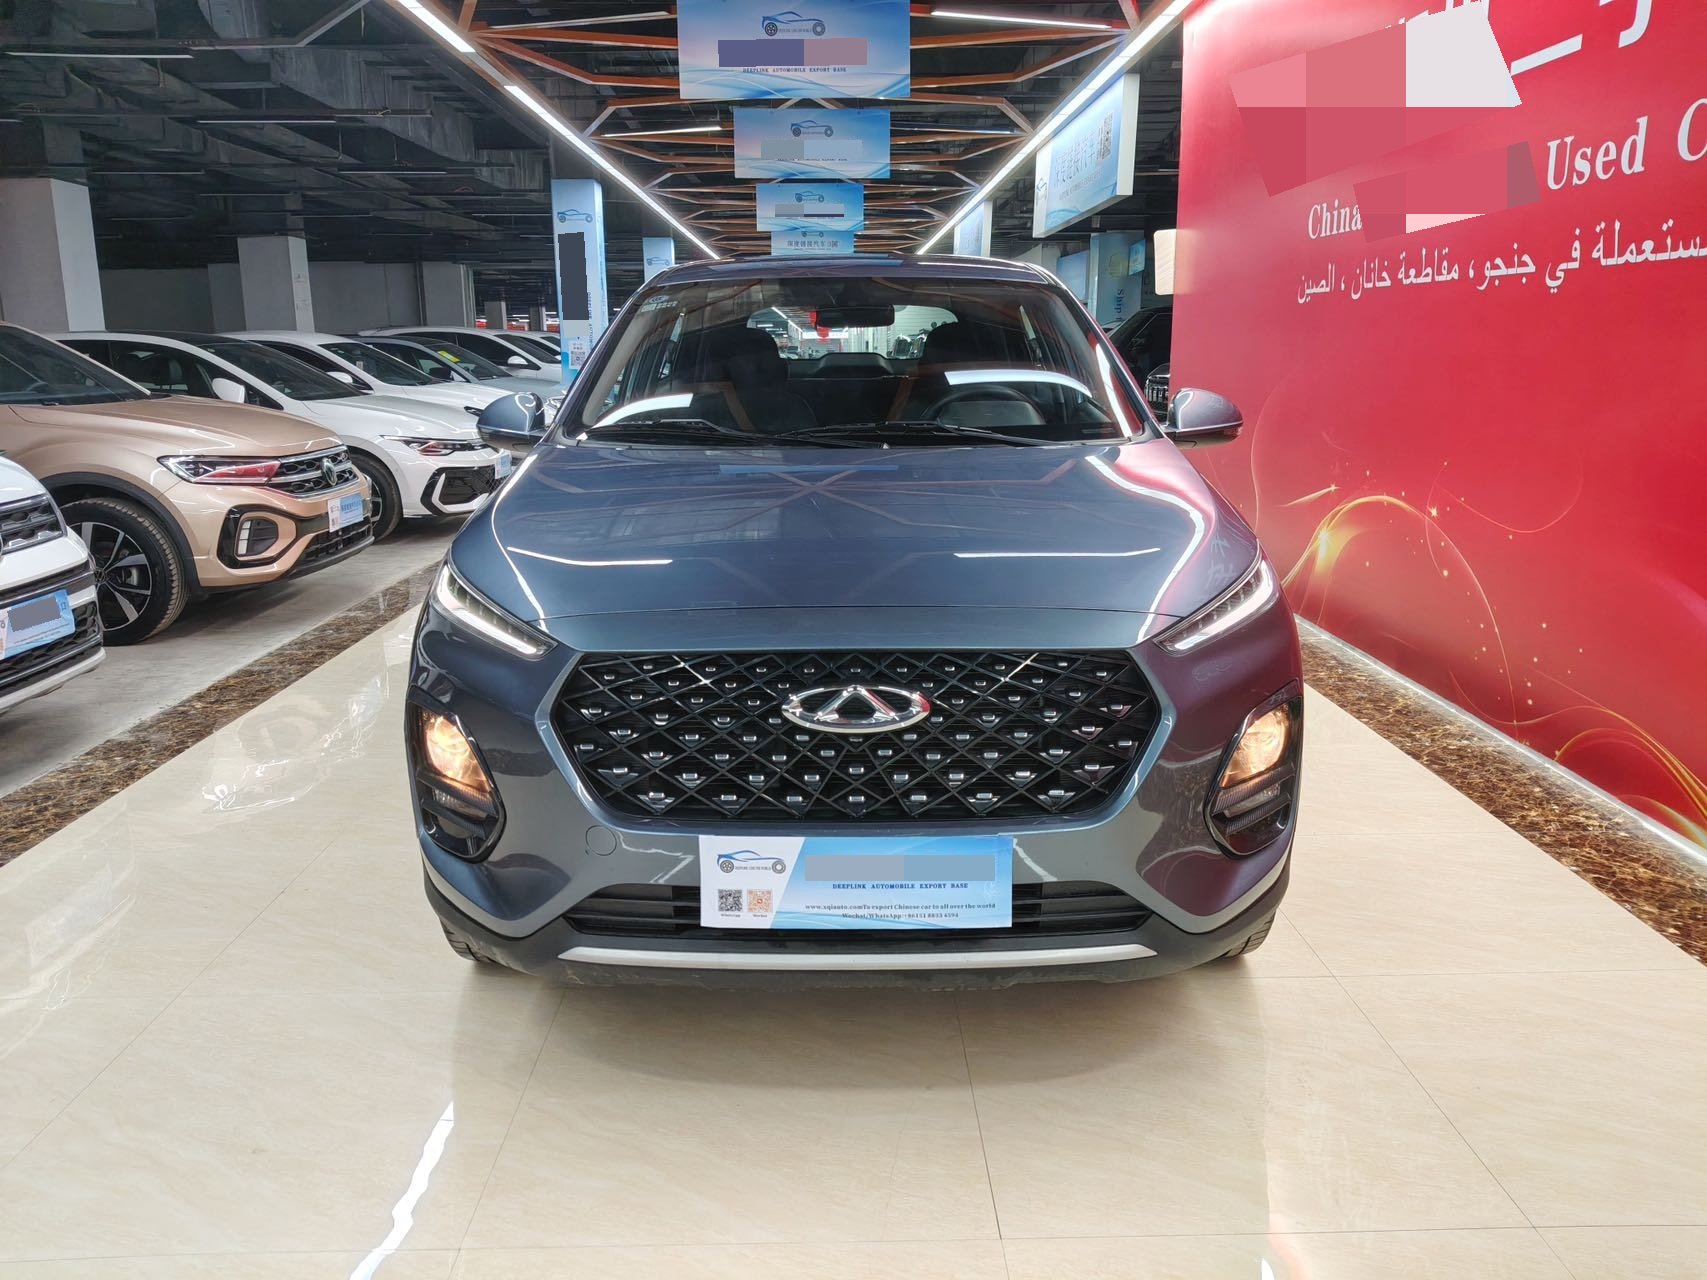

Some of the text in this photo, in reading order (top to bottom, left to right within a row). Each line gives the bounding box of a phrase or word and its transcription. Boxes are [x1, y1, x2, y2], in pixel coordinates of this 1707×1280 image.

[1308, 199, 1363, 239] China
[1546, 115, 1649, 190] Used
[1297, 264, 1335, 304] الصين
[1398, 247, 1459, 285] مقاطعة
[1545, 227, 1581, 293] في
